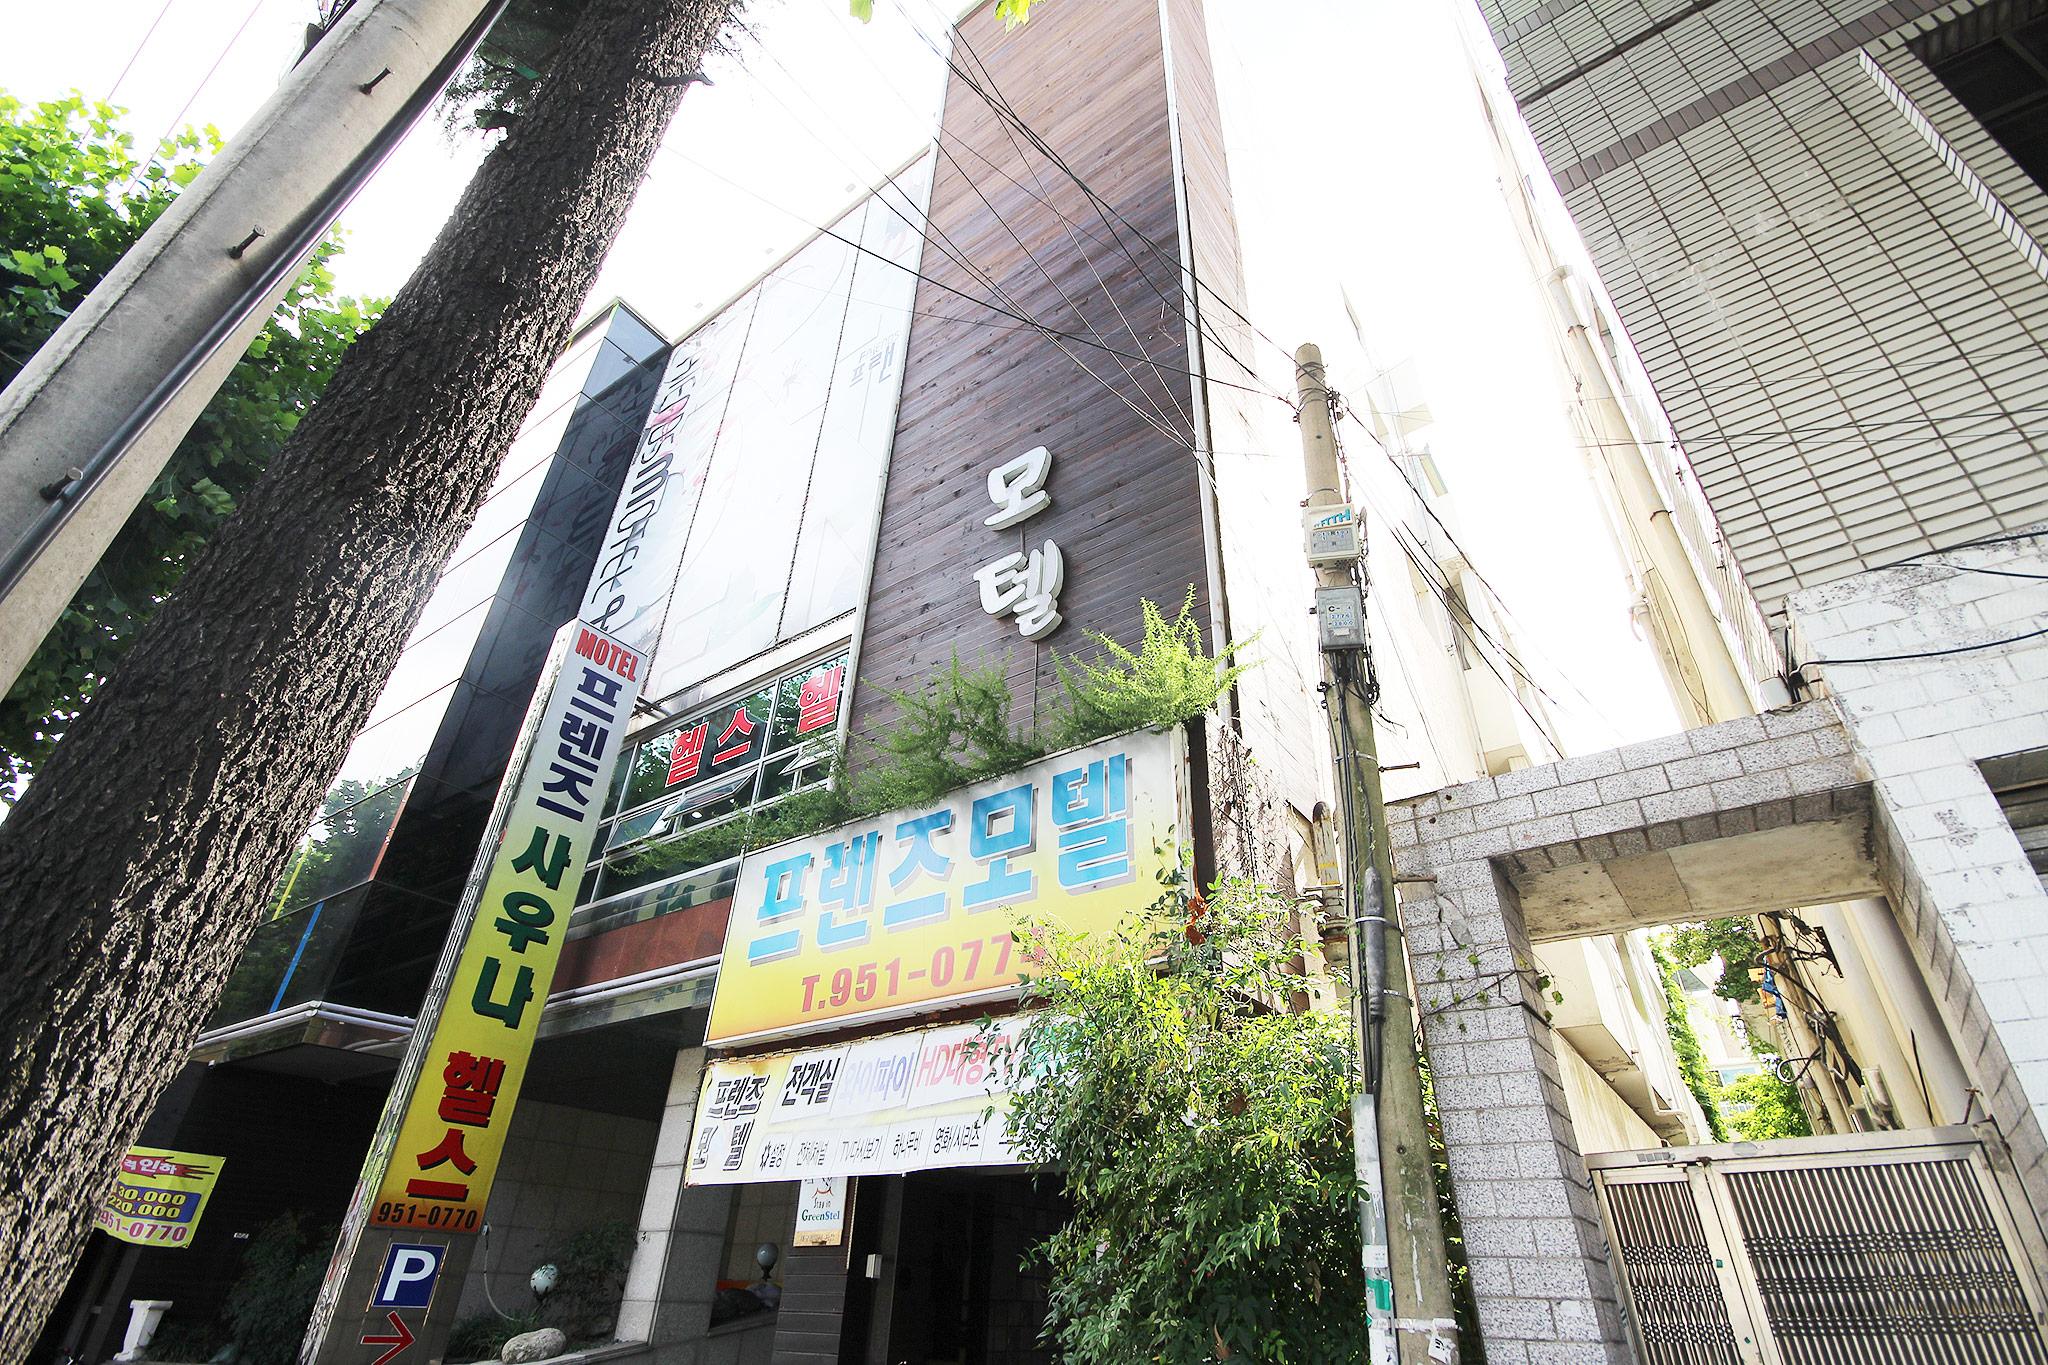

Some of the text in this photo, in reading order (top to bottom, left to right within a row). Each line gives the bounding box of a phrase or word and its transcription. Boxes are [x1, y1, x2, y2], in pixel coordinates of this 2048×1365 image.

[973, 444, 1064, 642] 모텔
[576, 628, 640, 683] MOTEL
[536, 666, 623, 822] 프렌즈
[664, 706, 757, 788] 헬스
[747, 752, 1133, 967] 프렌즈모텔
[471, 825, 573, 1030] 사우나
[707, 1076, 768, 1119] 프렌즈
[781, 1055, 841, 1107] 전객실
[405, 1051, 507, 1201] 헬스
[115, 1187, 187, 1206] 30,000
[377, 1200, 478, 1230] 951-0770
[801, 1208, 840, 1222] GreenStel
[382, 1248, 436, 1302] P
